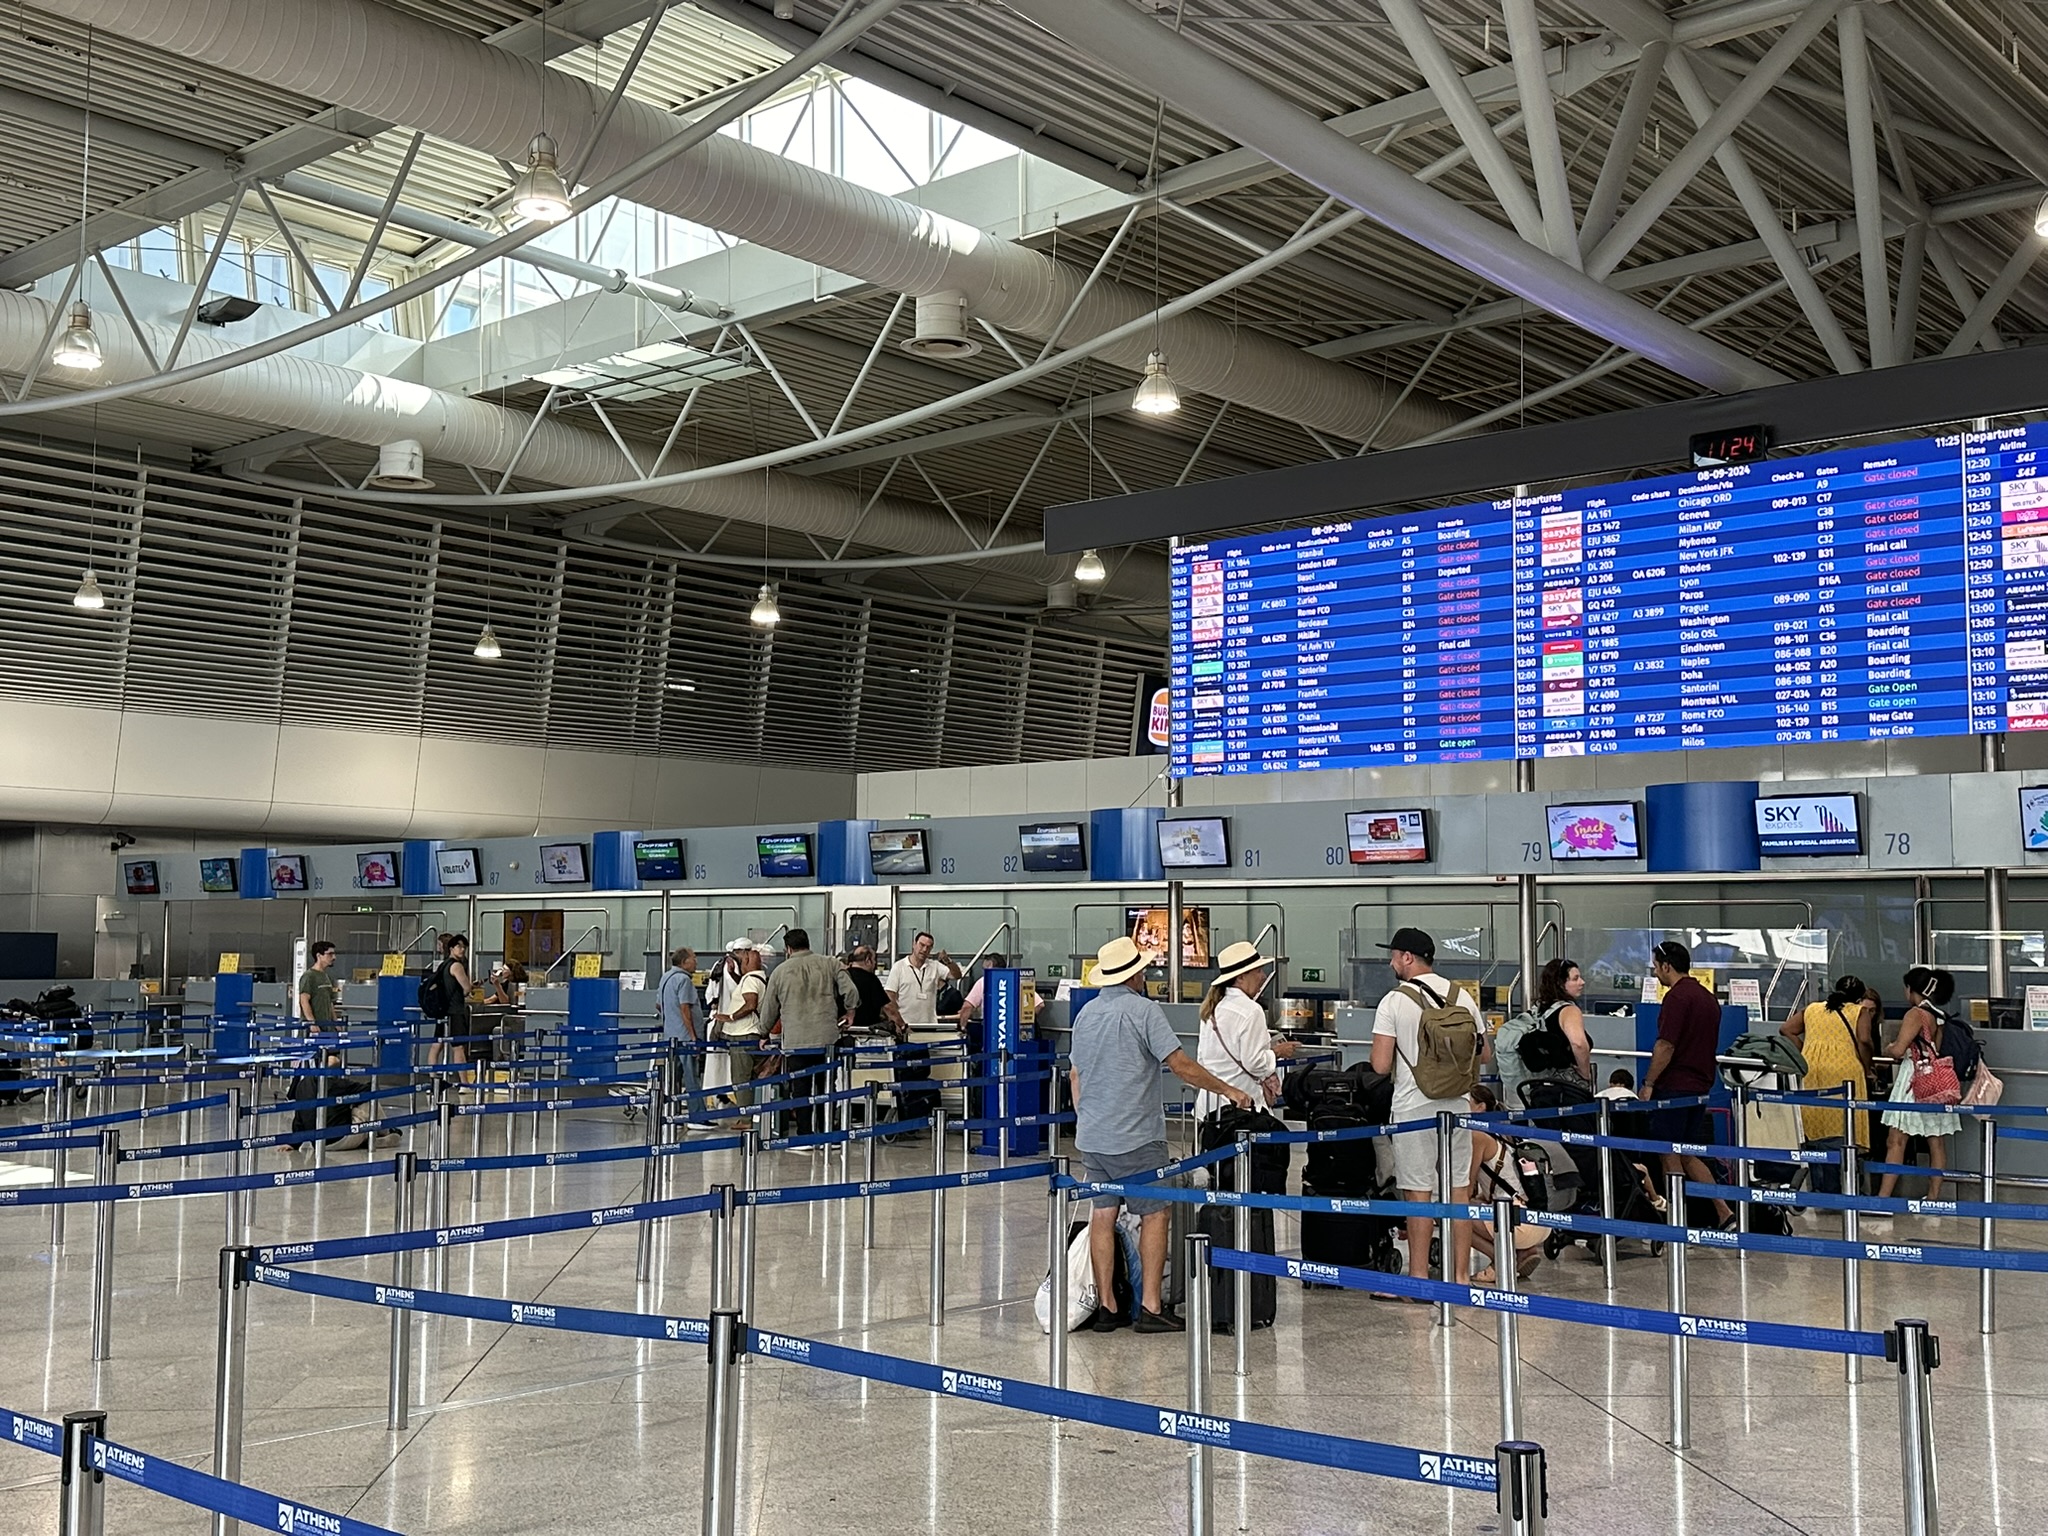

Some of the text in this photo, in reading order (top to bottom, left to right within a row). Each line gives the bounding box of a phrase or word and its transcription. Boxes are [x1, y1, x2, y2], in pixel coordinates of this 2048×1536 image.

[1935, 435, 1960, 447] 11:25
[1966, 427, 2026, 444] Departures
[2000, 441, 2026, 451] Airline
[1816, 467, 1838, 476] Gates
[1863, 458, 1897, 469] Remarks
[1967, 458, 1990, 469] 12:30
[1698, 465, 1750, 480] 08-09-2024
[1516, 493, 1562, 508] Departures
[1678, 480, 1828, 507] Chicago ORD A9
[1492, 500, 1511, 510] 11:25
[1678, 492, 1832, 520] Geneva 009-013 C17
[1968, 501, 1991, 512] 12:35
[1679, 506, 1834, 534] Milan MXP C38
[1968, 516, 1992, 526] 12:40
[1312, 523, 1352, 536] 08-09-2024
[1679, 520, 1834, 548] Mykonos B19
[1968, 530, 1992, 541] 12:45
[1679, 534, 1833, 560] New York JFK C32
[1969, 545, 1992, 555] 12:50
[1680, 548, 1834, 574] Rhodes B31
[1438, 565, 1471, 576] Departed
[1680, 562, 1834, 588] Lyon C18
[1970, 574, 1992, 584] 12:55
[1680, 575, 1841, 600] Paros B16A
[1970, 588, 1994, 598] 13:00
[1680, 590, 1834, 614] Prague C37
[1680, 604, 1835, 626] Washington A15
[1680, 618, 1836, 640] Oslo OSL 019-021 C34
[1971, 617, 1995, 628] 13:05
[1439, 639, 1470, 650] Final call
[1680, 632, 1836, 653] Eindhoven C36
[1681, 645, 1836, 667] Naples B20
[1970, 647, 1995, 657] 13:10
[1298, 664, 1327, 675] Santorini
[1681, 660, 1837, 680] Doha A20
[1681, 673, 1837, 693] Santorini B22
[1682, 687, 1837, 706] Montreal YUL 027-034 A22
[1153, 706, 1168, 717] BUR
[1298, 712, 1320, 721] Chania
[1708, 709, 1724, 718] FCO
[1776, 703, 1809, 714] 136-140
[1822, 701, 1837, 711] B15
[1973, 706, 1996, 715] 13:15
[1682, 715, 1839, 733] Sofia B28
[1682, 729, 1838, 746] Milos B16
[1298, 748, 1328, 756] Frankfurt
[1458, 740, 1476, 748] open
[1764, 806, 1804, 830] SKY express
[1884, 833, 1910, 855] 78
[1245, 850, 1260, 867] 81
[1326, 847, 1344, 865] 80
[1522, 842, 1542, 862] 79
[748, 864, 760, 878] 84
[941, 858, 955, 874] 83
[1004, 856, 1018, 872] 82
[490, 872, 499, 885] 87
[694, 864, 706, 880] 85
[998, 979, 1007, 1049] RYANAIR
[360, 1121, 382, 1129] ATHENS
[136, 1148, 161, 1156] ATHENS
[1682, 1145, 1707, 1153] ATHENS
[1801, 1151, 1827, 1160] ATHENS
[286, 1171, 315, 1179] ATHENS
[969, 1172, 989, 1180] ATHENS
[142, 1182, 174, 1191] ATHENS
[1763, 1190, 1796, 1200] ATHENS
[1342, 1200, 1370, 1209] ATHENS
[1921, 1201, 1957, 1209] ATHENS
[604, 1208, 634, 1216] ATHENS
[1540, 1212, 1573, 1222] ATHENS
[450, 1226, 485, 1237] ATHENS
[1700, 1232, 1738, 1242] ATHENS
[275, 1244, 314, 1256] ATHENS
[1881, 1246, 1922, 1258] ATHENS
[264, 1268, 290, 1281] ATHENS
[1301, 1264, 1339, 1278] ATHENS
[386, 1289, 415, 1300] ATHENS
[1486, 1291, 1529, 1306] ATHENS
[523, 1306, 556, 1318] ATHENS
[679, 1320, 710, 1333] ATHEN
[1698, 1319, 1747, 1332] ATHENS
[772, 1336, 811, 1354] ATHENS
[958, 1374, 1002, 1391] ATHENS
[23, 1419, 54, 1438] ATHENS
[1177, 1414, 1230, 1433] ATHENS
[107, 1447, 145, 1469] ATHENS
[1443, 1458, 1496, 1476] ATHEN
[1442, 1469, 1482, 1480] INTERNATIONAL
[294, 1508, 340, 1534] ATHENS
